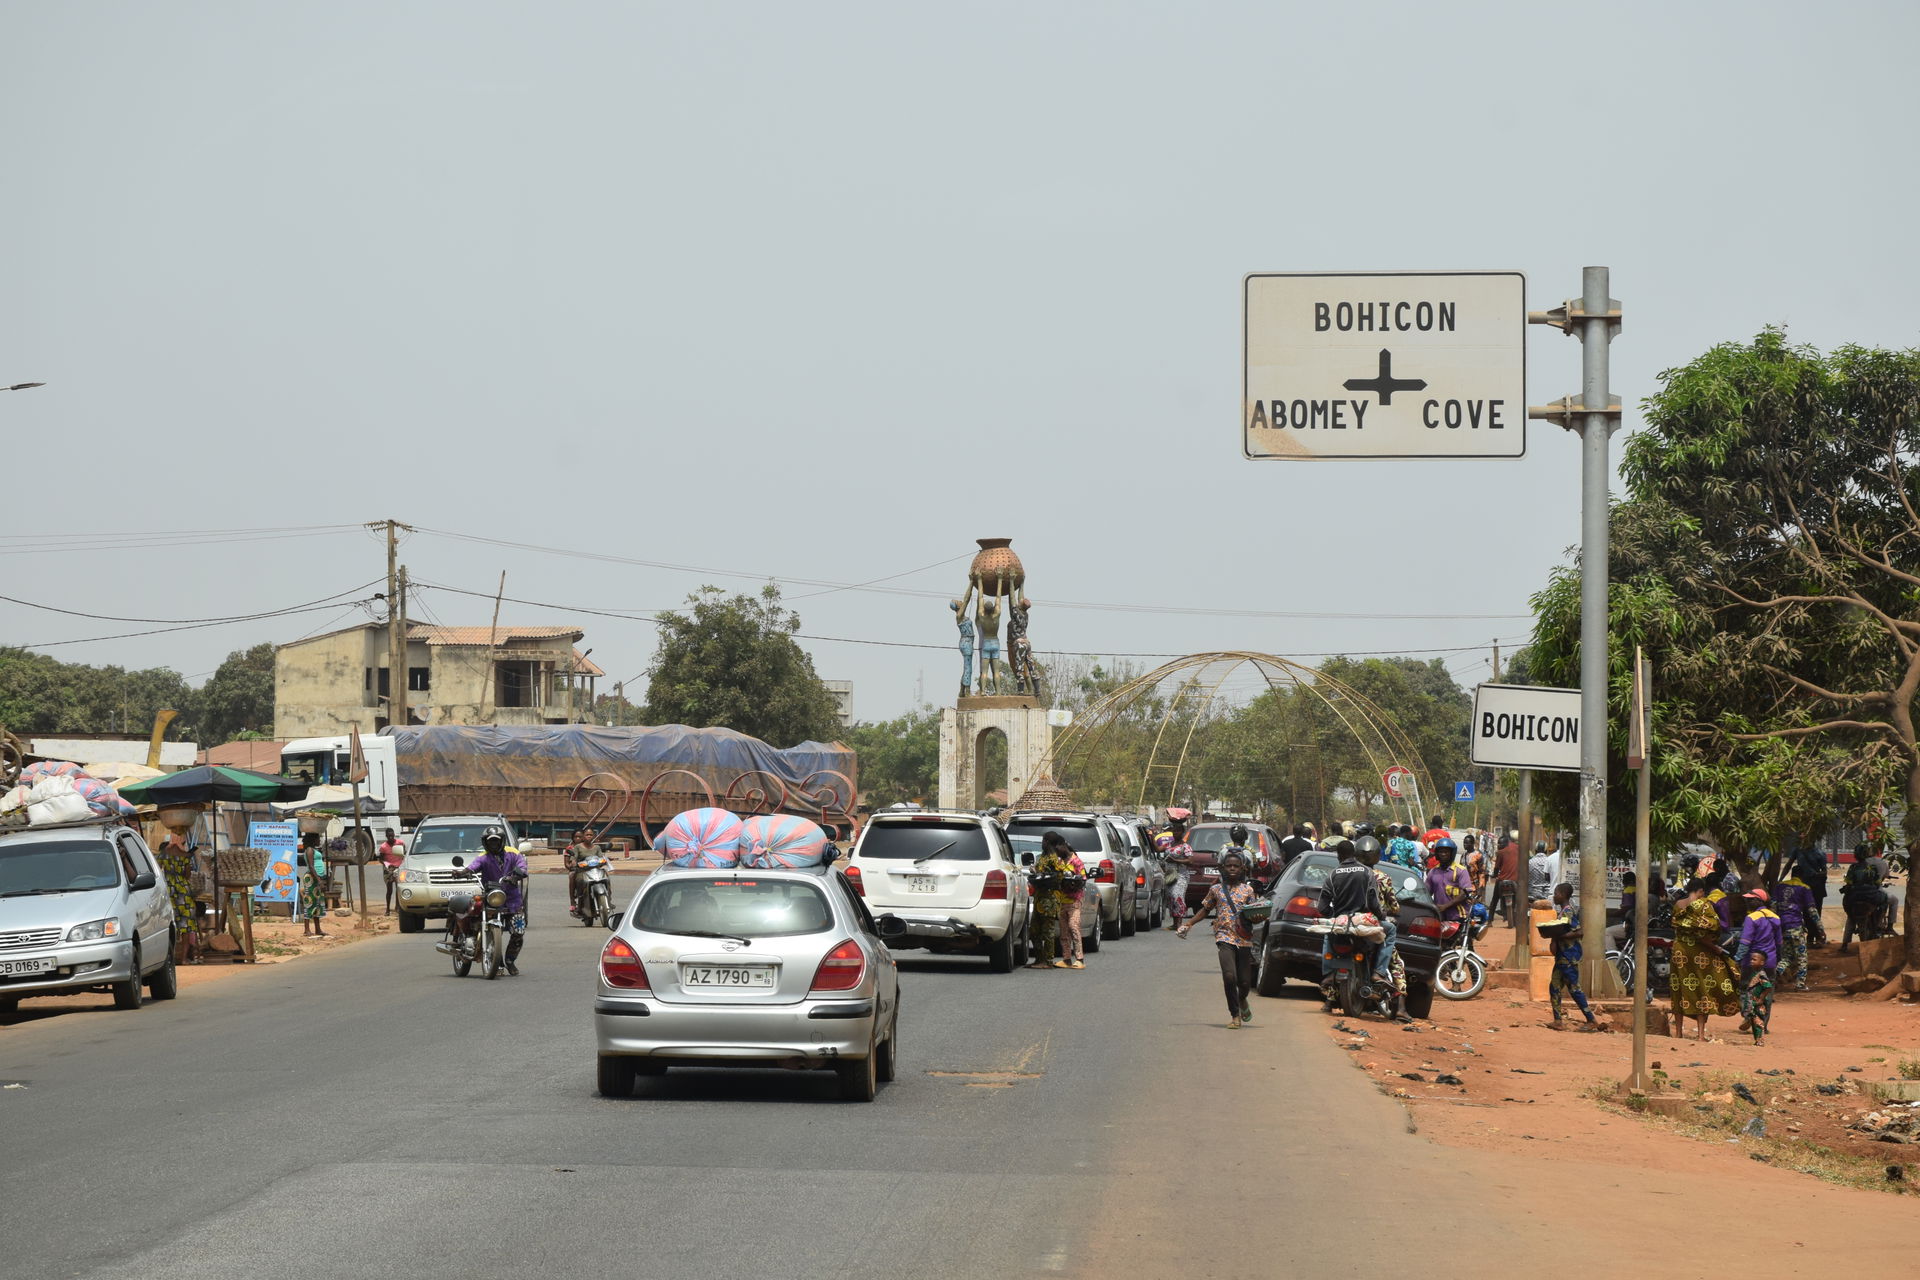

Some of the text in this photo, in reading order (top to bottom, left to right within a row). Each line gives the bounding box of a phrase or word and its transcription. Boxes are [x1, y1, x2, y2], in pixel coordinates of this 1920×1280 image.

[1314, 302, 1456, 332] BOHICON
[1250, 399, 1505, 429] ABOMEY COVE
[1481, 711, 1579, 744] BOHICON
[15, 960, 40, 973] 0169
[689, 969, 712, 984] AZ
[715, 969, 751, 985] 1790
